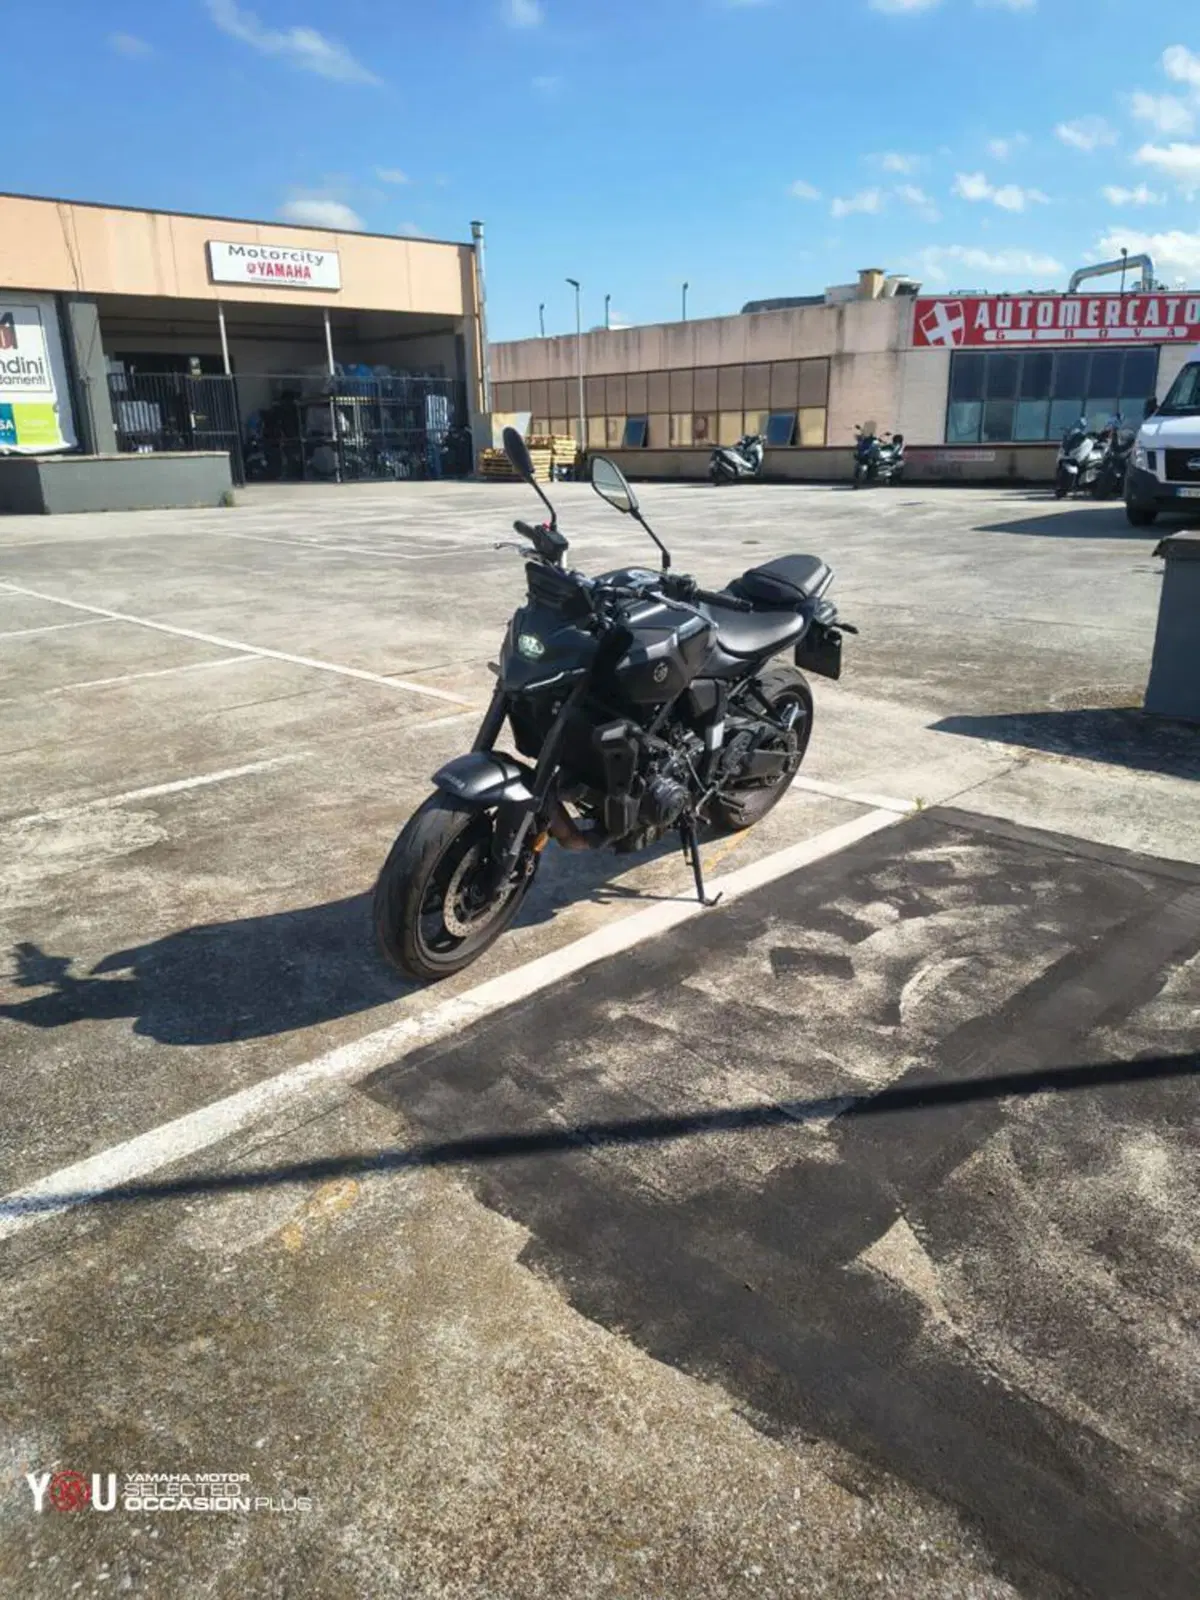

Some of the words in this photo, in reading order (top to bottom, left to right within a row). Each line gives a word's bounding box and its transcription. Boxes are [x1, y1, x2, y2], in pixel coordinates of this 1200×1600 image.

[228, 245, 324, 266] Motorcity
[258, 262, 311, 279] YAMAHA
[974, 300, 1200, 328] AUTOMERCATO
